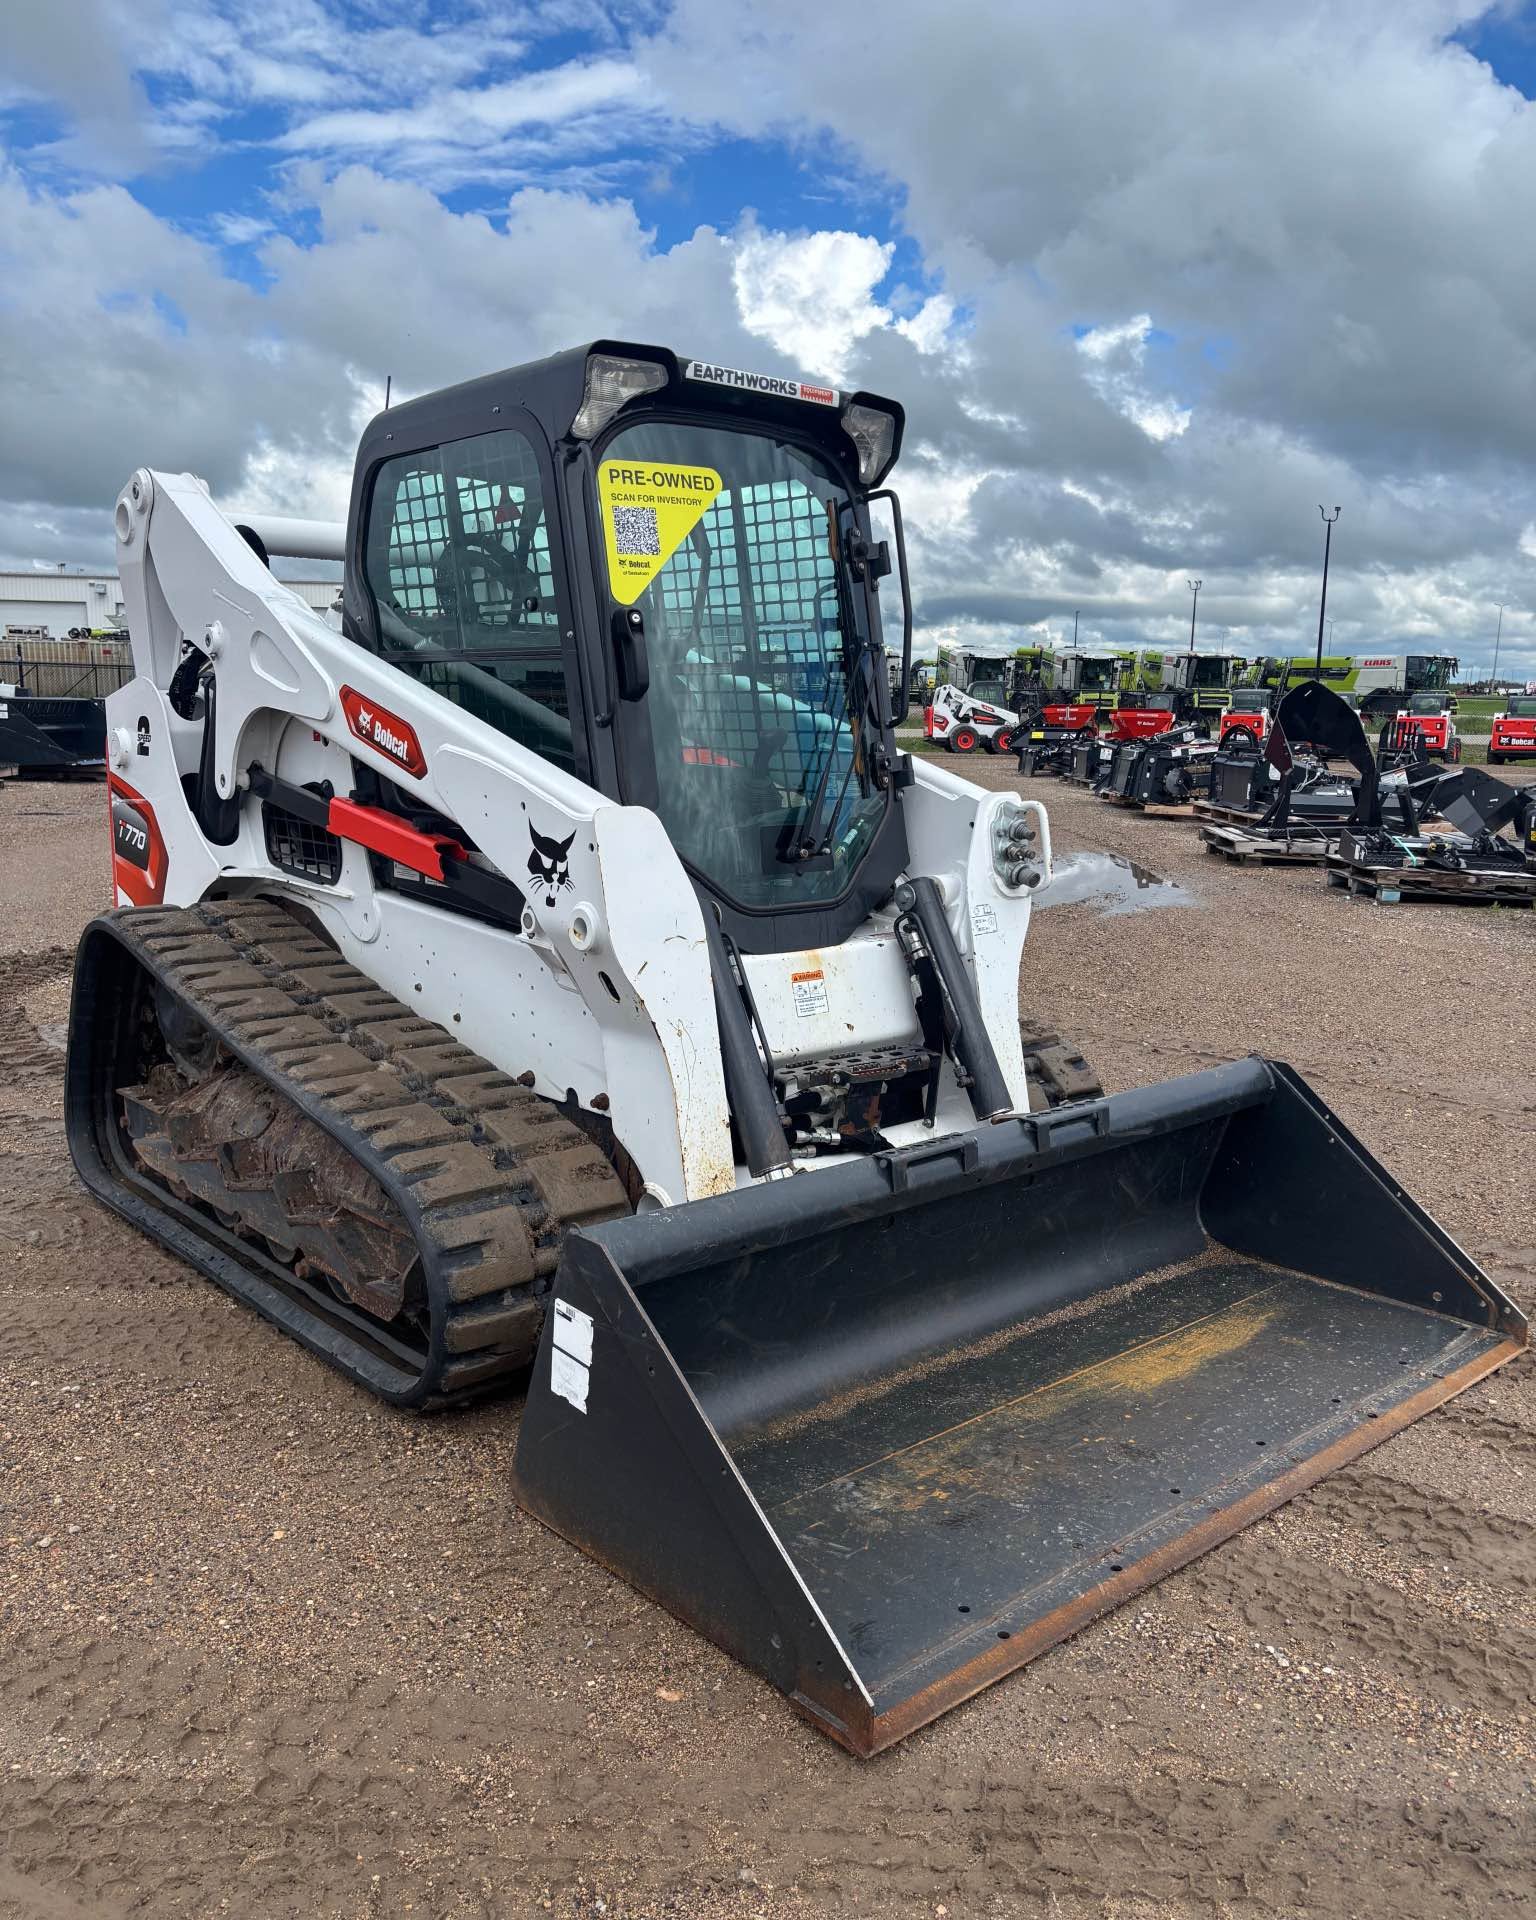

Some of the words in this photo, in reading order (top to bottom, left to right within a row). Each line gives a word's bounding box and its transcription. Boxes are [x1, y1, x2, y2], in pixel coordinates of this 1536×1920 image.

[693, 363, 798, 396] EARTHWORKS
[608, 468, 715, 491] PRE-OWNED
[610, 493, 636, 502] SCAN
[637, 494, 655, 503] FOR
[657, 496, 702, 506] INVENTORY
[628, 560, 651, 569] Bobcat
[1363, 659, 1393, 667] CLAAS
[137, 733, 152, 743] SPEED
[373, 720, 409, 761] Bobcat
[1511, 738, 1535, 746] Bobcat
[119, 819, 147, 850] T770
